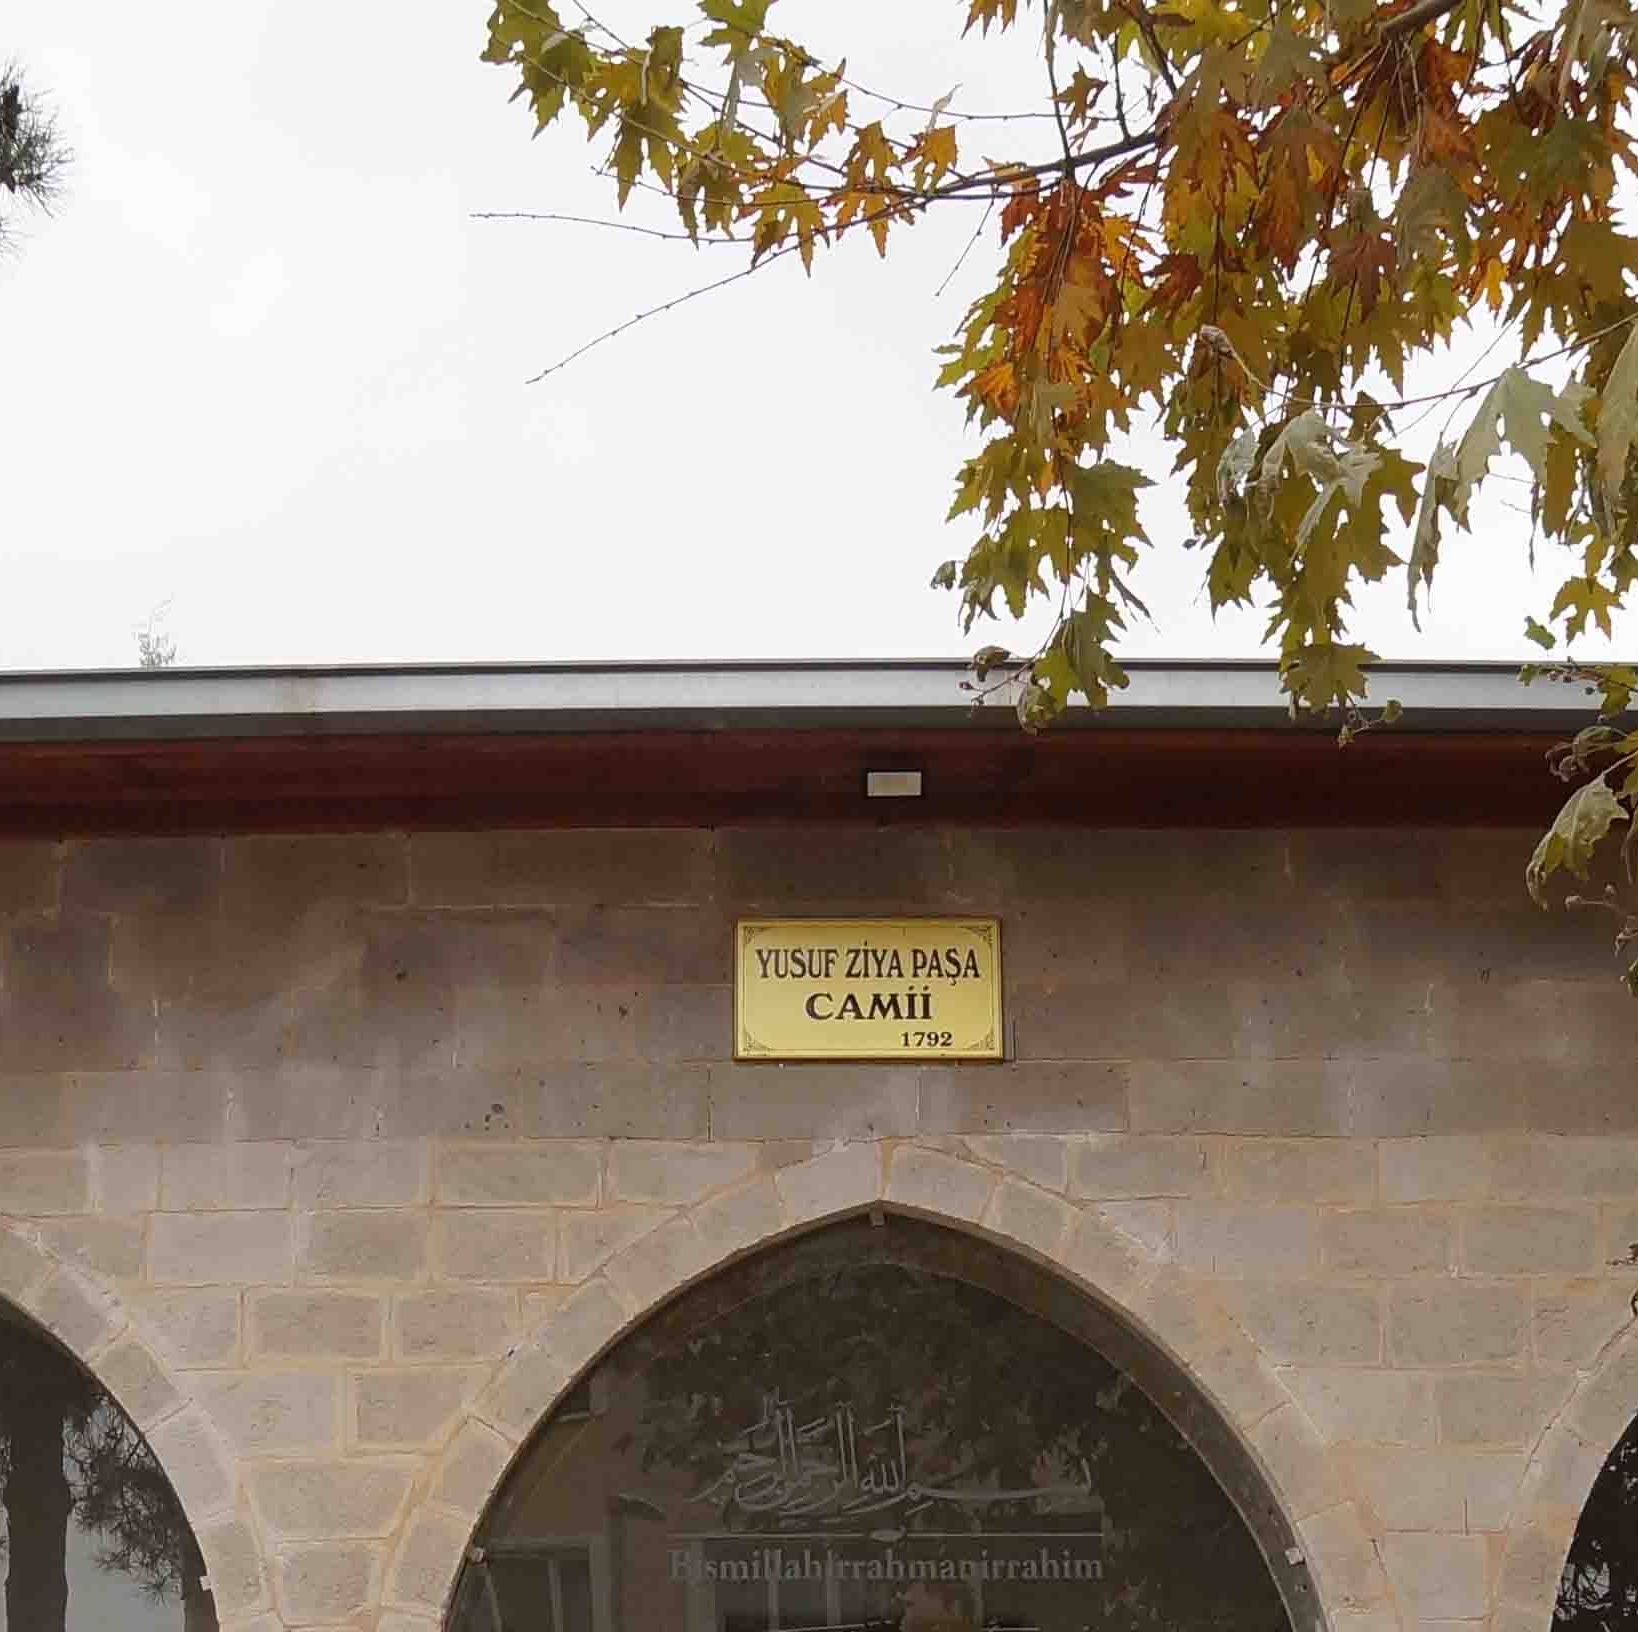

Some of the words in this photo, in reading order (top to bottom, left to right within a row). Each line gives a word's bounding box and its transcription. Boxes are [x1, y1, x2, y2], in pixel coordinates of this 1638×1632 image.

[756, 948, 839, 979] YUSUF
[846, 940, 904, 979] ZİYA
[912, 948, 981, 986] PAŞA
[804, 985, 932, 1020] CAMİİ
[901, 1031, 953, 1048] 1792
